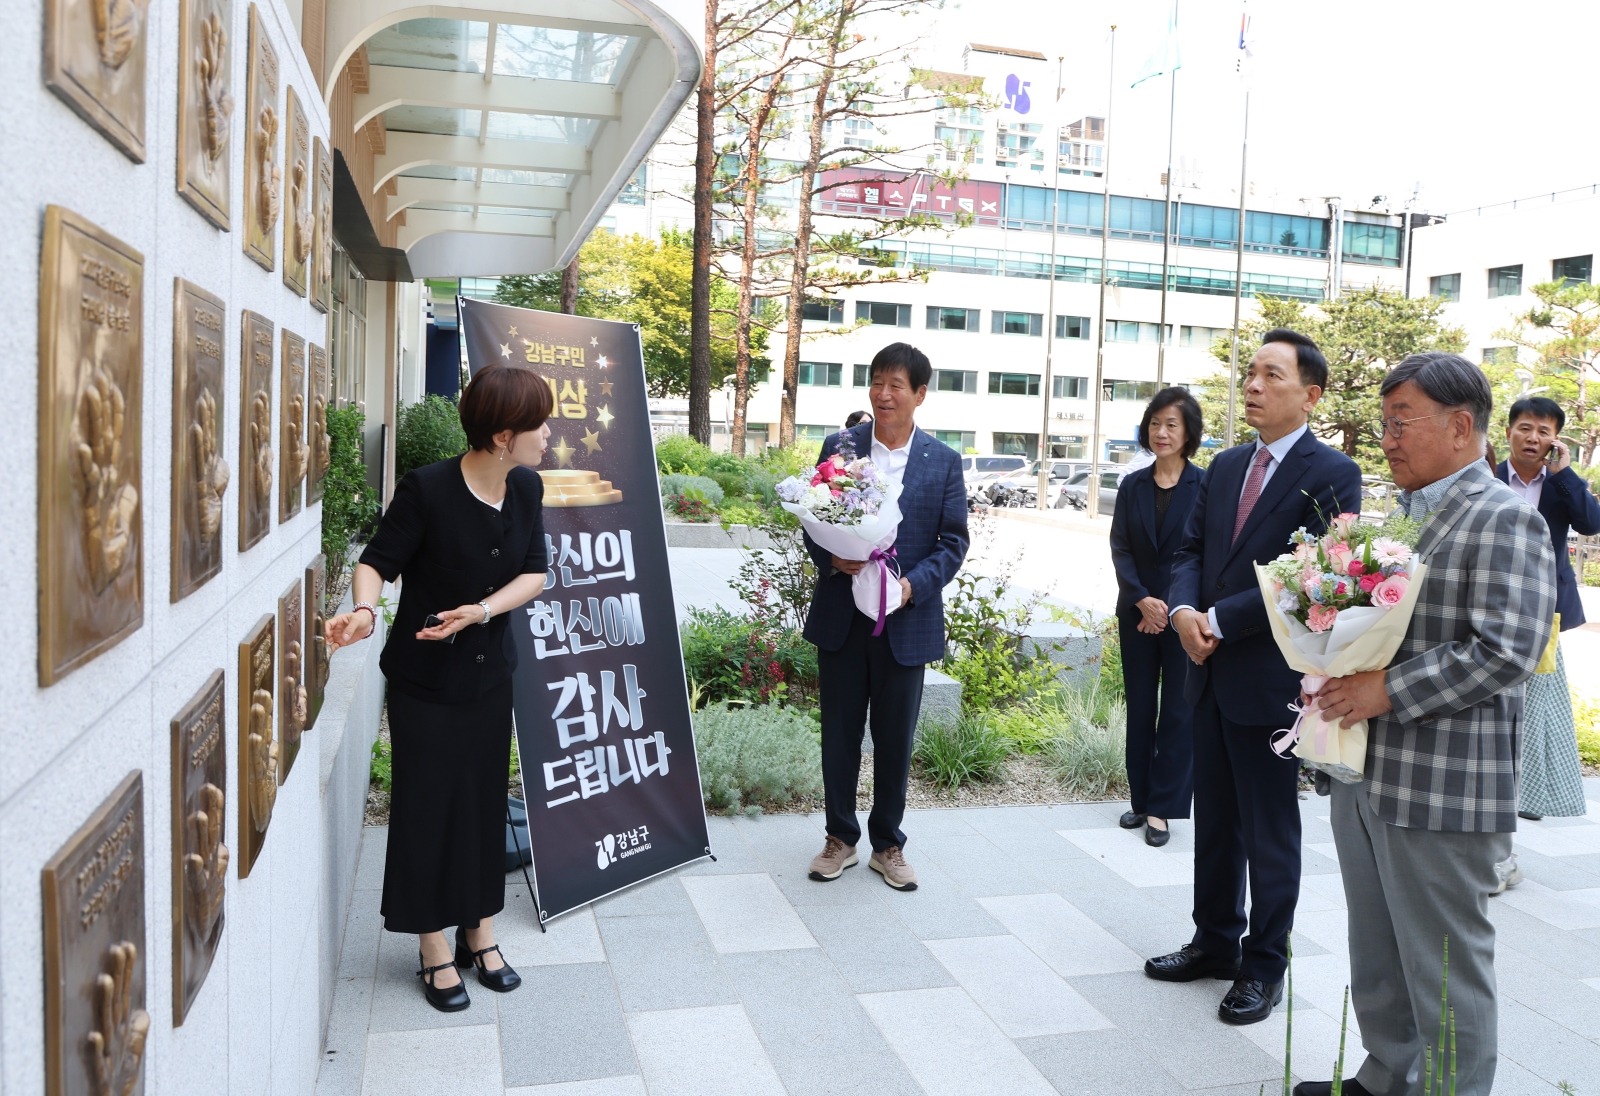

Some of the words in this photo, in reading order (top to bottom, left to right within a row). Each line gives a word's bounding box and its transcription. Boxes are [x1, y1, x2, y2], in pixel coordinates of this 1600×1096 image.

[525, 341, 586, 368] 강남구민
[526, 592, 645, 660] 헌신에
[546, 664, 647, 749] 감사
[543, 731, 672, 808] 드립니다
[616, 825, 649, 850] 강남구
